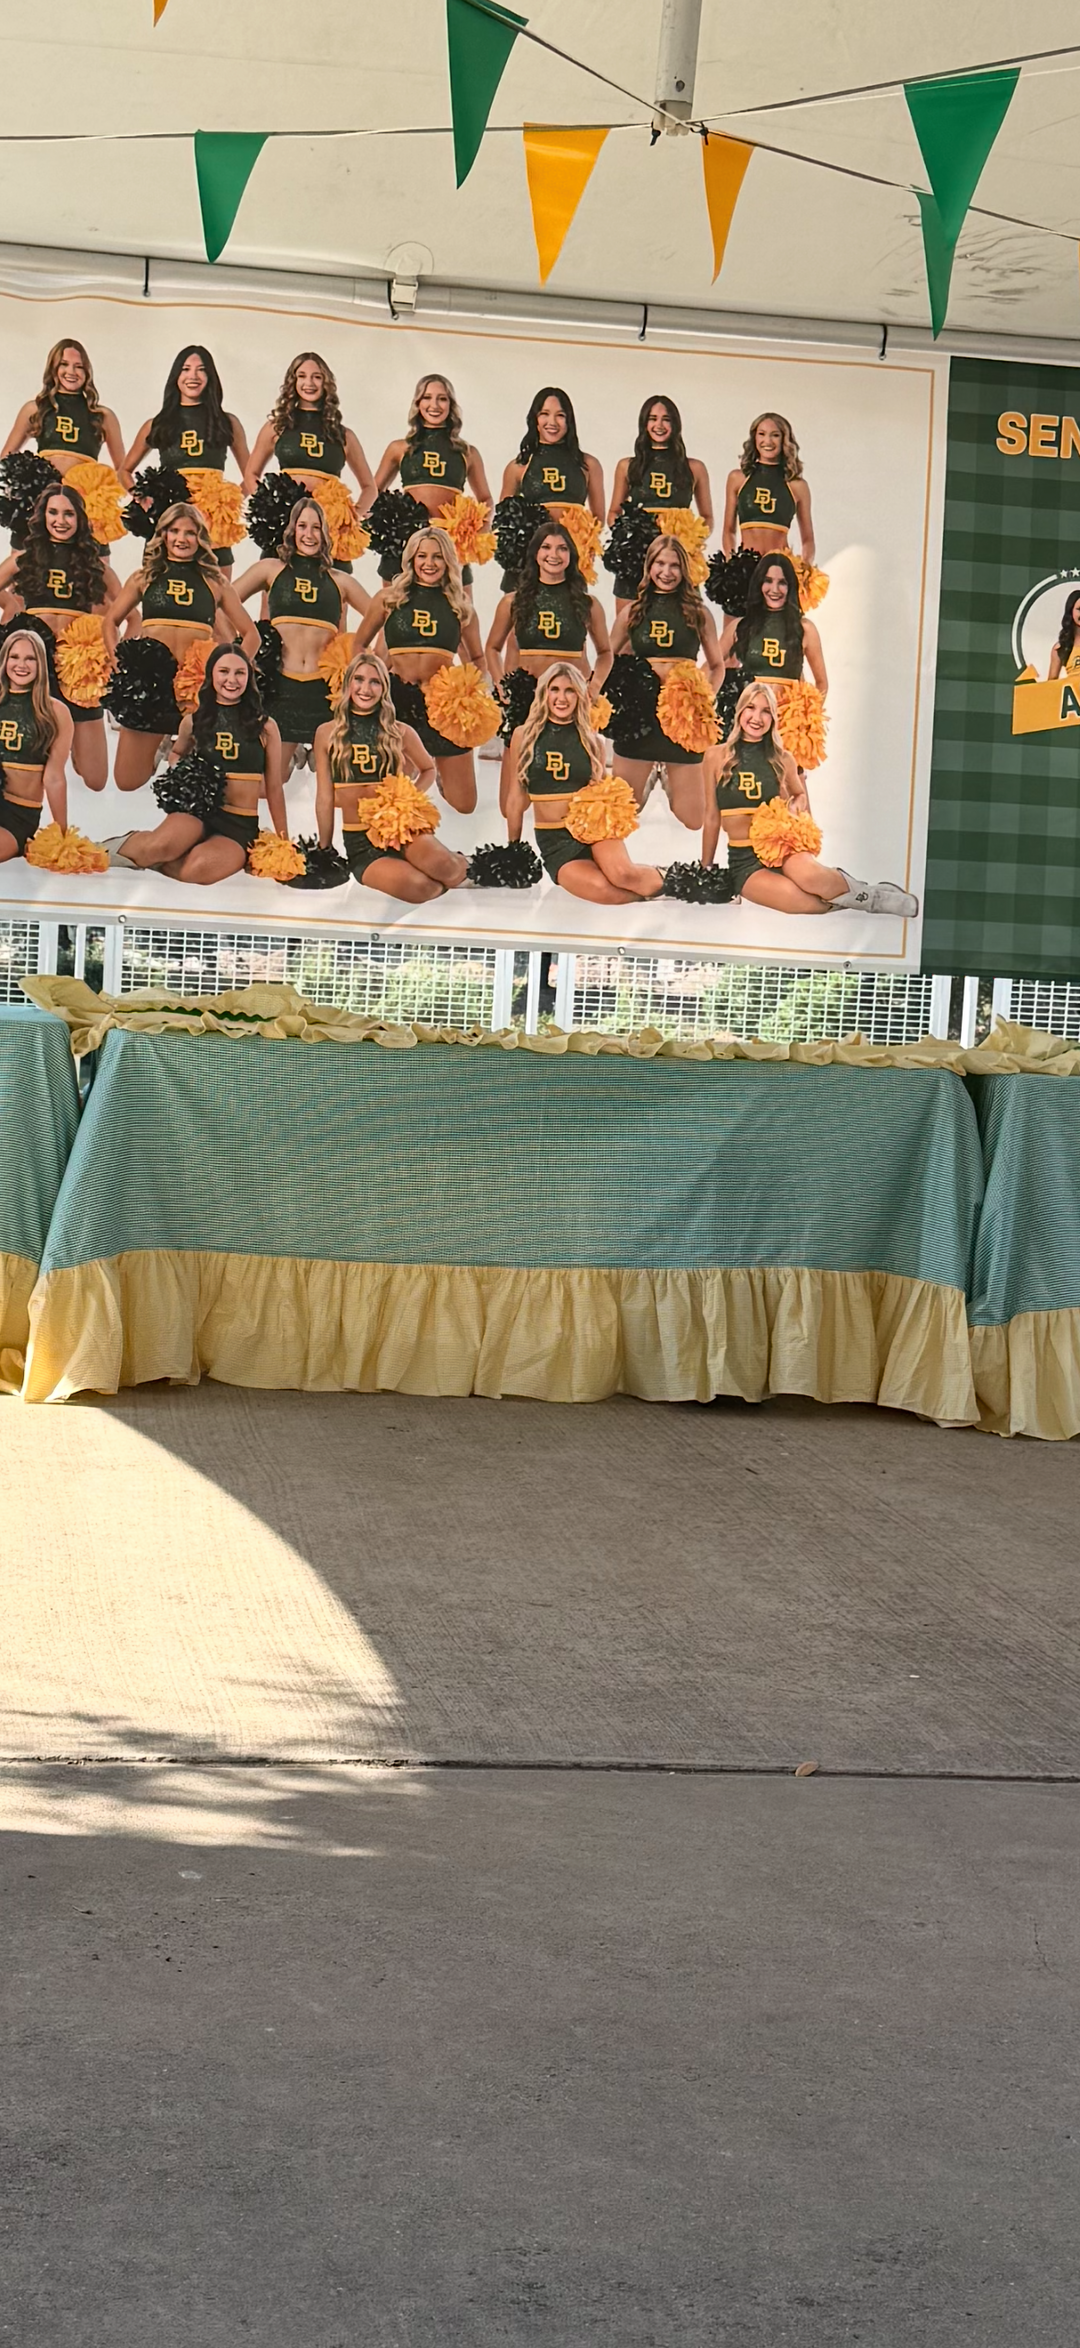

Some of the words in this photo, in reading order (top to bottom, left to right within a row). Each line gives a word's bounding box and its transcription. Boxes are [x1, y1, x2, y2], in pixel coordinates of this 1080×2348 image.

[55, 416, 80, 442] BU
[996, 411, 1080, 459] SEN
[180, 430, 204, 456] BU
[300, 432, 324, 457] BU
[423, 451, 446, 478] BU
[542, 467, 566, 492] BU
[650, 472, 672, 498] BU
[754, 487, 777, 514] BU
[167, 579, 194, 606] BU
[294, 577, 318, 603] BU
[412, 610, 438, 637] BU
[538, 611, 561, 639] BU
[650, 620, 675, 647] BU
[762, 638, 786, 667] BU
[0, 720, 24, 751] BU
[215, 732, 240, 760] BU
[353, 744, 377, 773] BU
[546, 751, 570, 781] BU
[738, 771, 762, 800] BU
